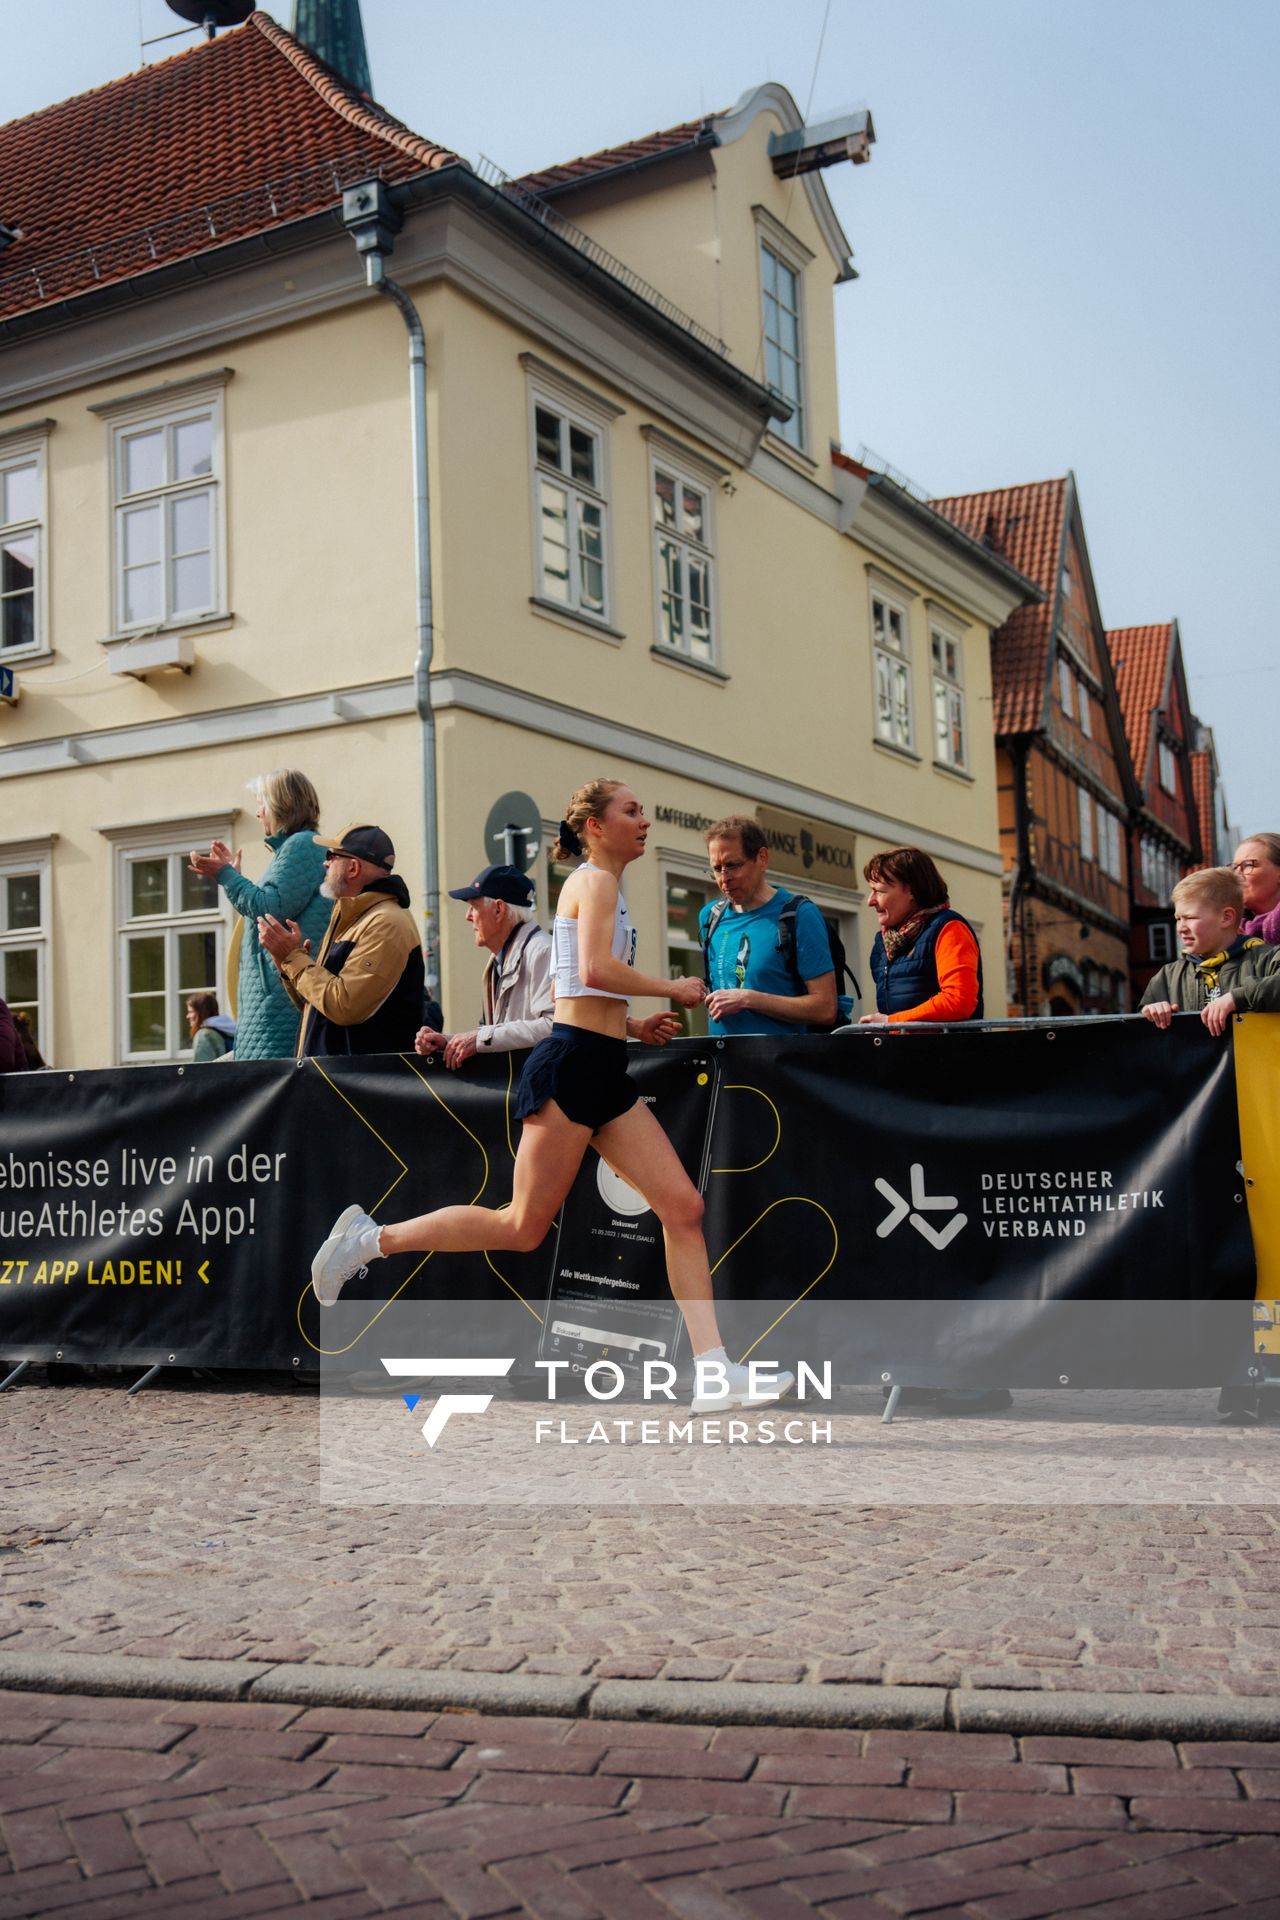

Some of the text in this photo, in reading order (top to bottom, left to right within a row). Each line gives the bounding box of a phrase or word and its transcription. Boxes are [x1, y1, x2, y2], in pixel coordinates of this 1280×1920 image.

[816, 842, 854, 869] MOCCA
[0, 1144, 286, 1189] ebnisse live in der
[981, 1171, 1114, 1191] DEUTSCHER
[982, 1190, 1165, 1214] LEICHTATHLETIK
[0, 1198, 256, 1244] ueAthletes App!
[611, 1219, 639, 1229] Diskuswurf
[983, 1219, 1087, 1238] VERBAND
[621, 1232, 636, 1241] HALLE
[636, 1234, 656, 1244] (SAALE)
[33, 1260, 79, 1285] APP
[87, 1260, 182, 1285] LADEN!
[560, 1268, 640, 1291] Alle Wettkampfergebnisse
